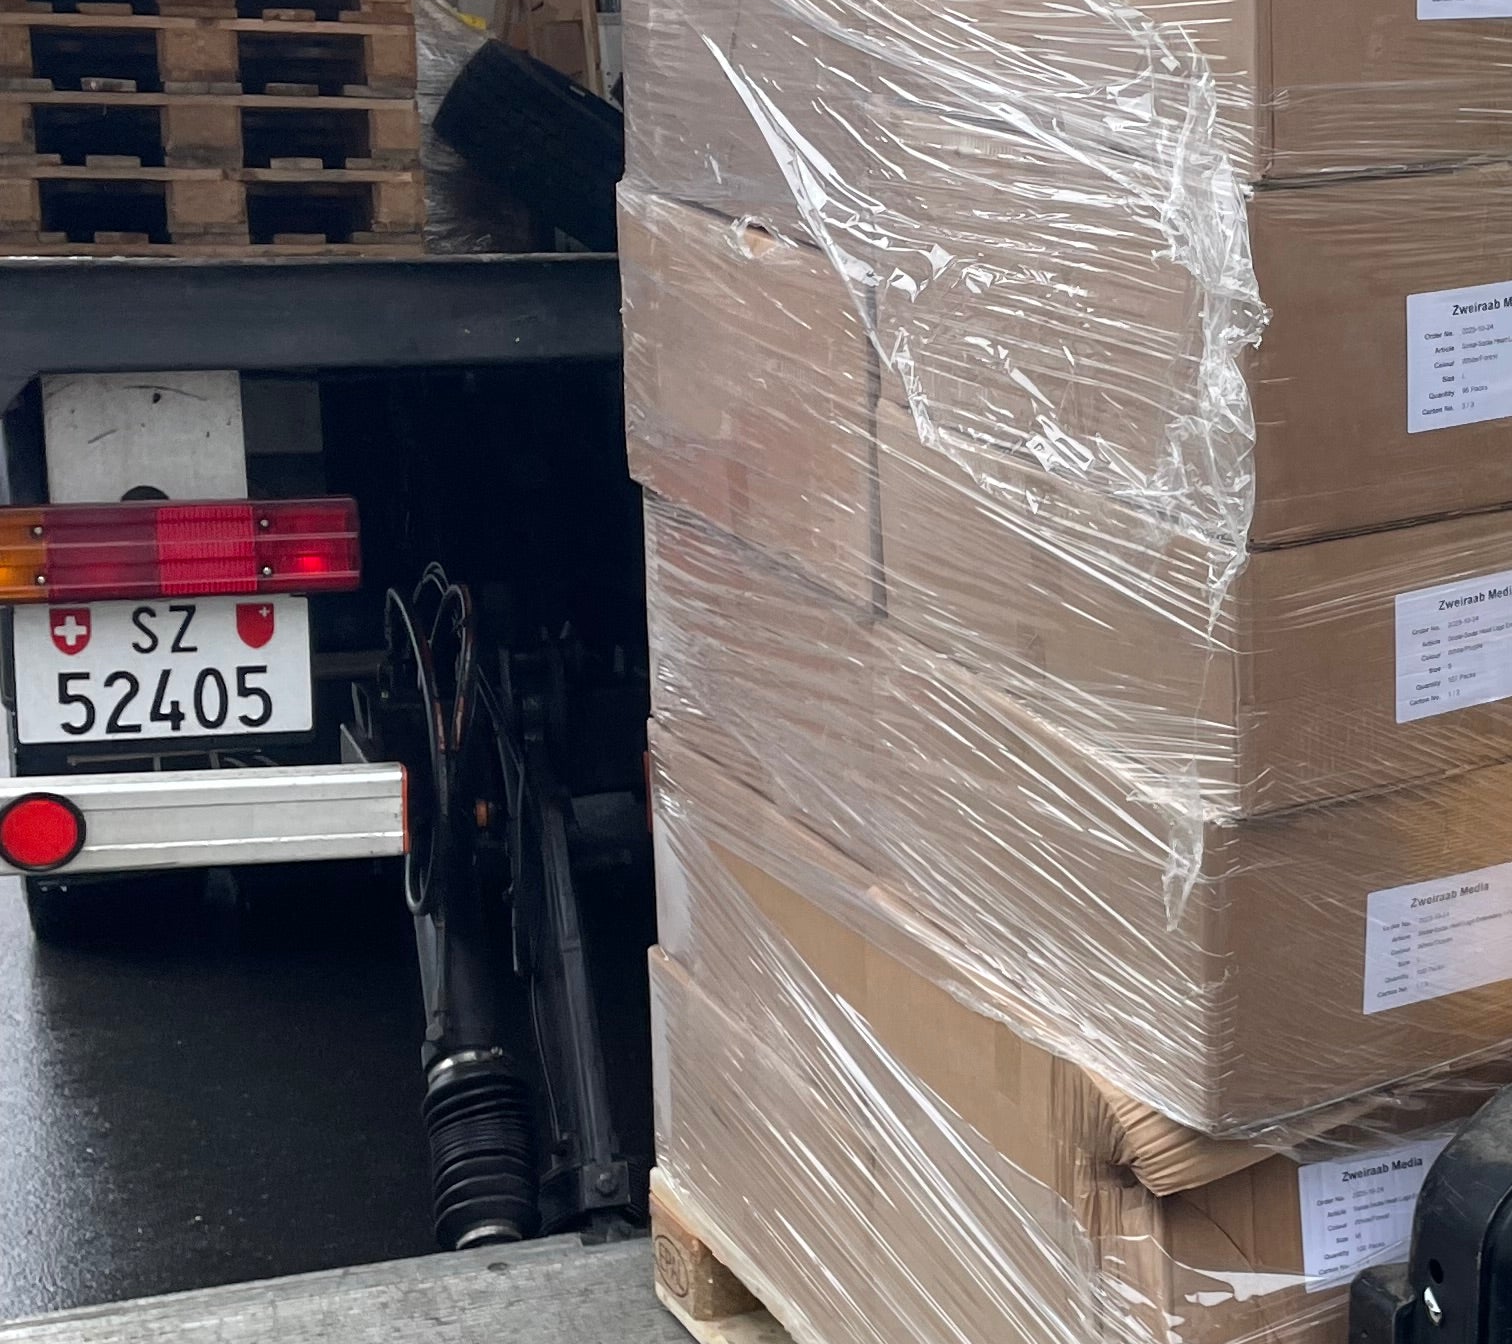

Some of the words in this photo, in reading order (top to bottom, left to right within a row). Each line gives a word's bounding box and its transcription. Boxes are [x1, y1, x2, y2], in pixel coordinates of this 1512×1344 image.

[1451, 298, 1500, 316] Zweiraab
[1438, 590, 1484, 611] Zweiraab
[132, 605, 198, 654] SZ
[58, 665, 273, 735] 52405
[1410, 888, 1457, 909] Zweiraab
[1459, 880, 1489, 897] Media
[1341, 1162, 1388, 1182] Zweiraab
[1391, 1155, 1423, 1171] Media
